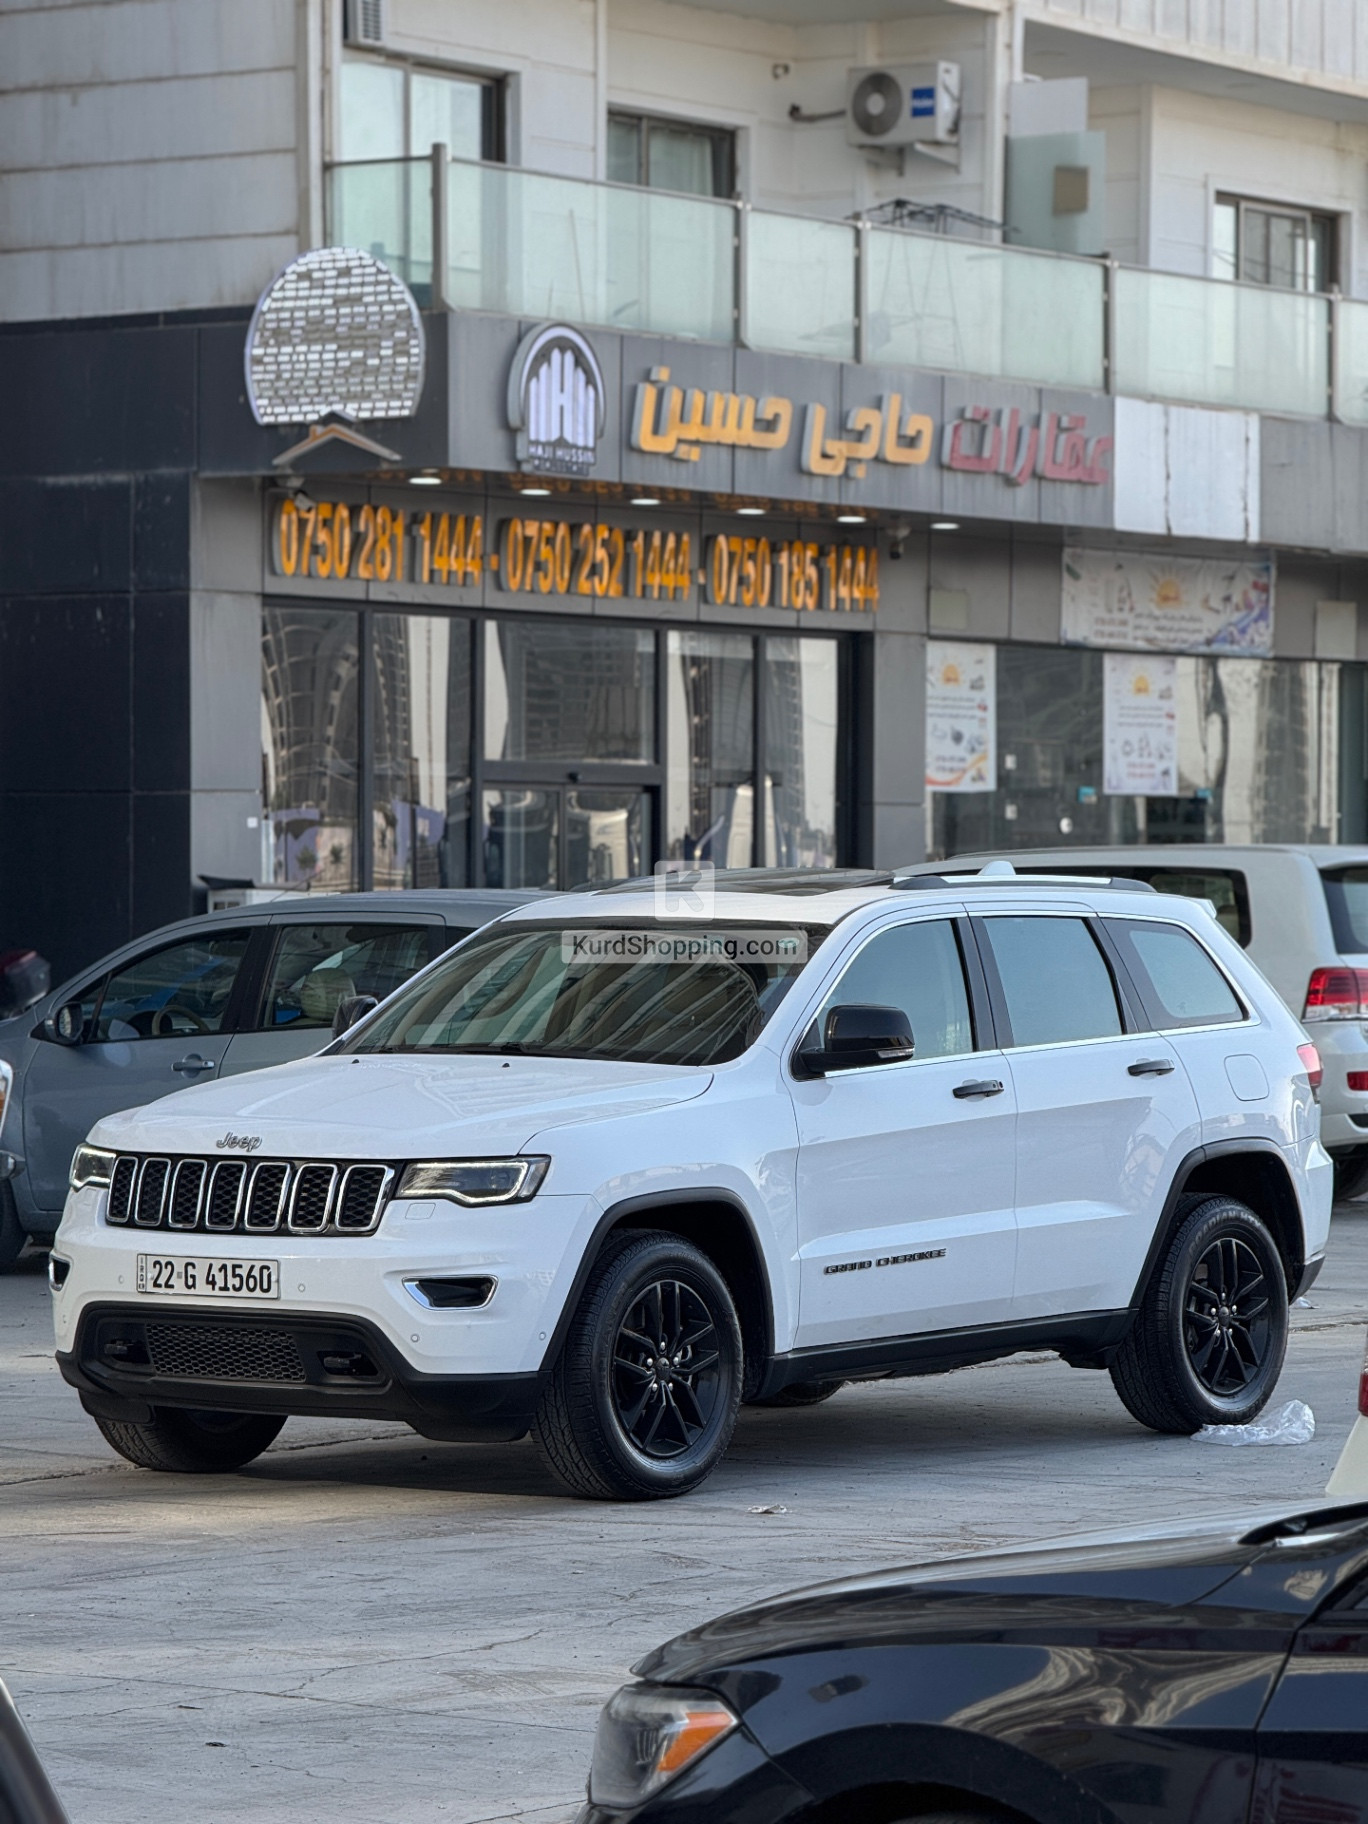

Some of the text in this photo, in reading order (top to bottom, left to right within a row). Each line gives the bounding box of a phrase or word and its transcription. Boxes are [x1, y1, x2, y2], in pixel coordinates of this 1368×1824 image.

[632, 366, 793, 461] حسين
[943, 405, 1114, 486] عقارات
[279, 499, 350, 578] 0750
[358, 504, 405, 581] 281
[419, 511, 482, 586] 1444
[507, 517, 571, 594] 0750
[577, 523, 624, 597] 252
[633, 529, 690, 600] 1444
[713, 533, 771, 608] 0750
[779, 540, 819, 611] 185
[827, 544, 880, 612] 1444
[216, 1131, 263, 1152] Jeep
[152, 1260, 272, 1294] 22 G 41560
[824, 1248, 947, 1275] GRAND CHEROKEE
